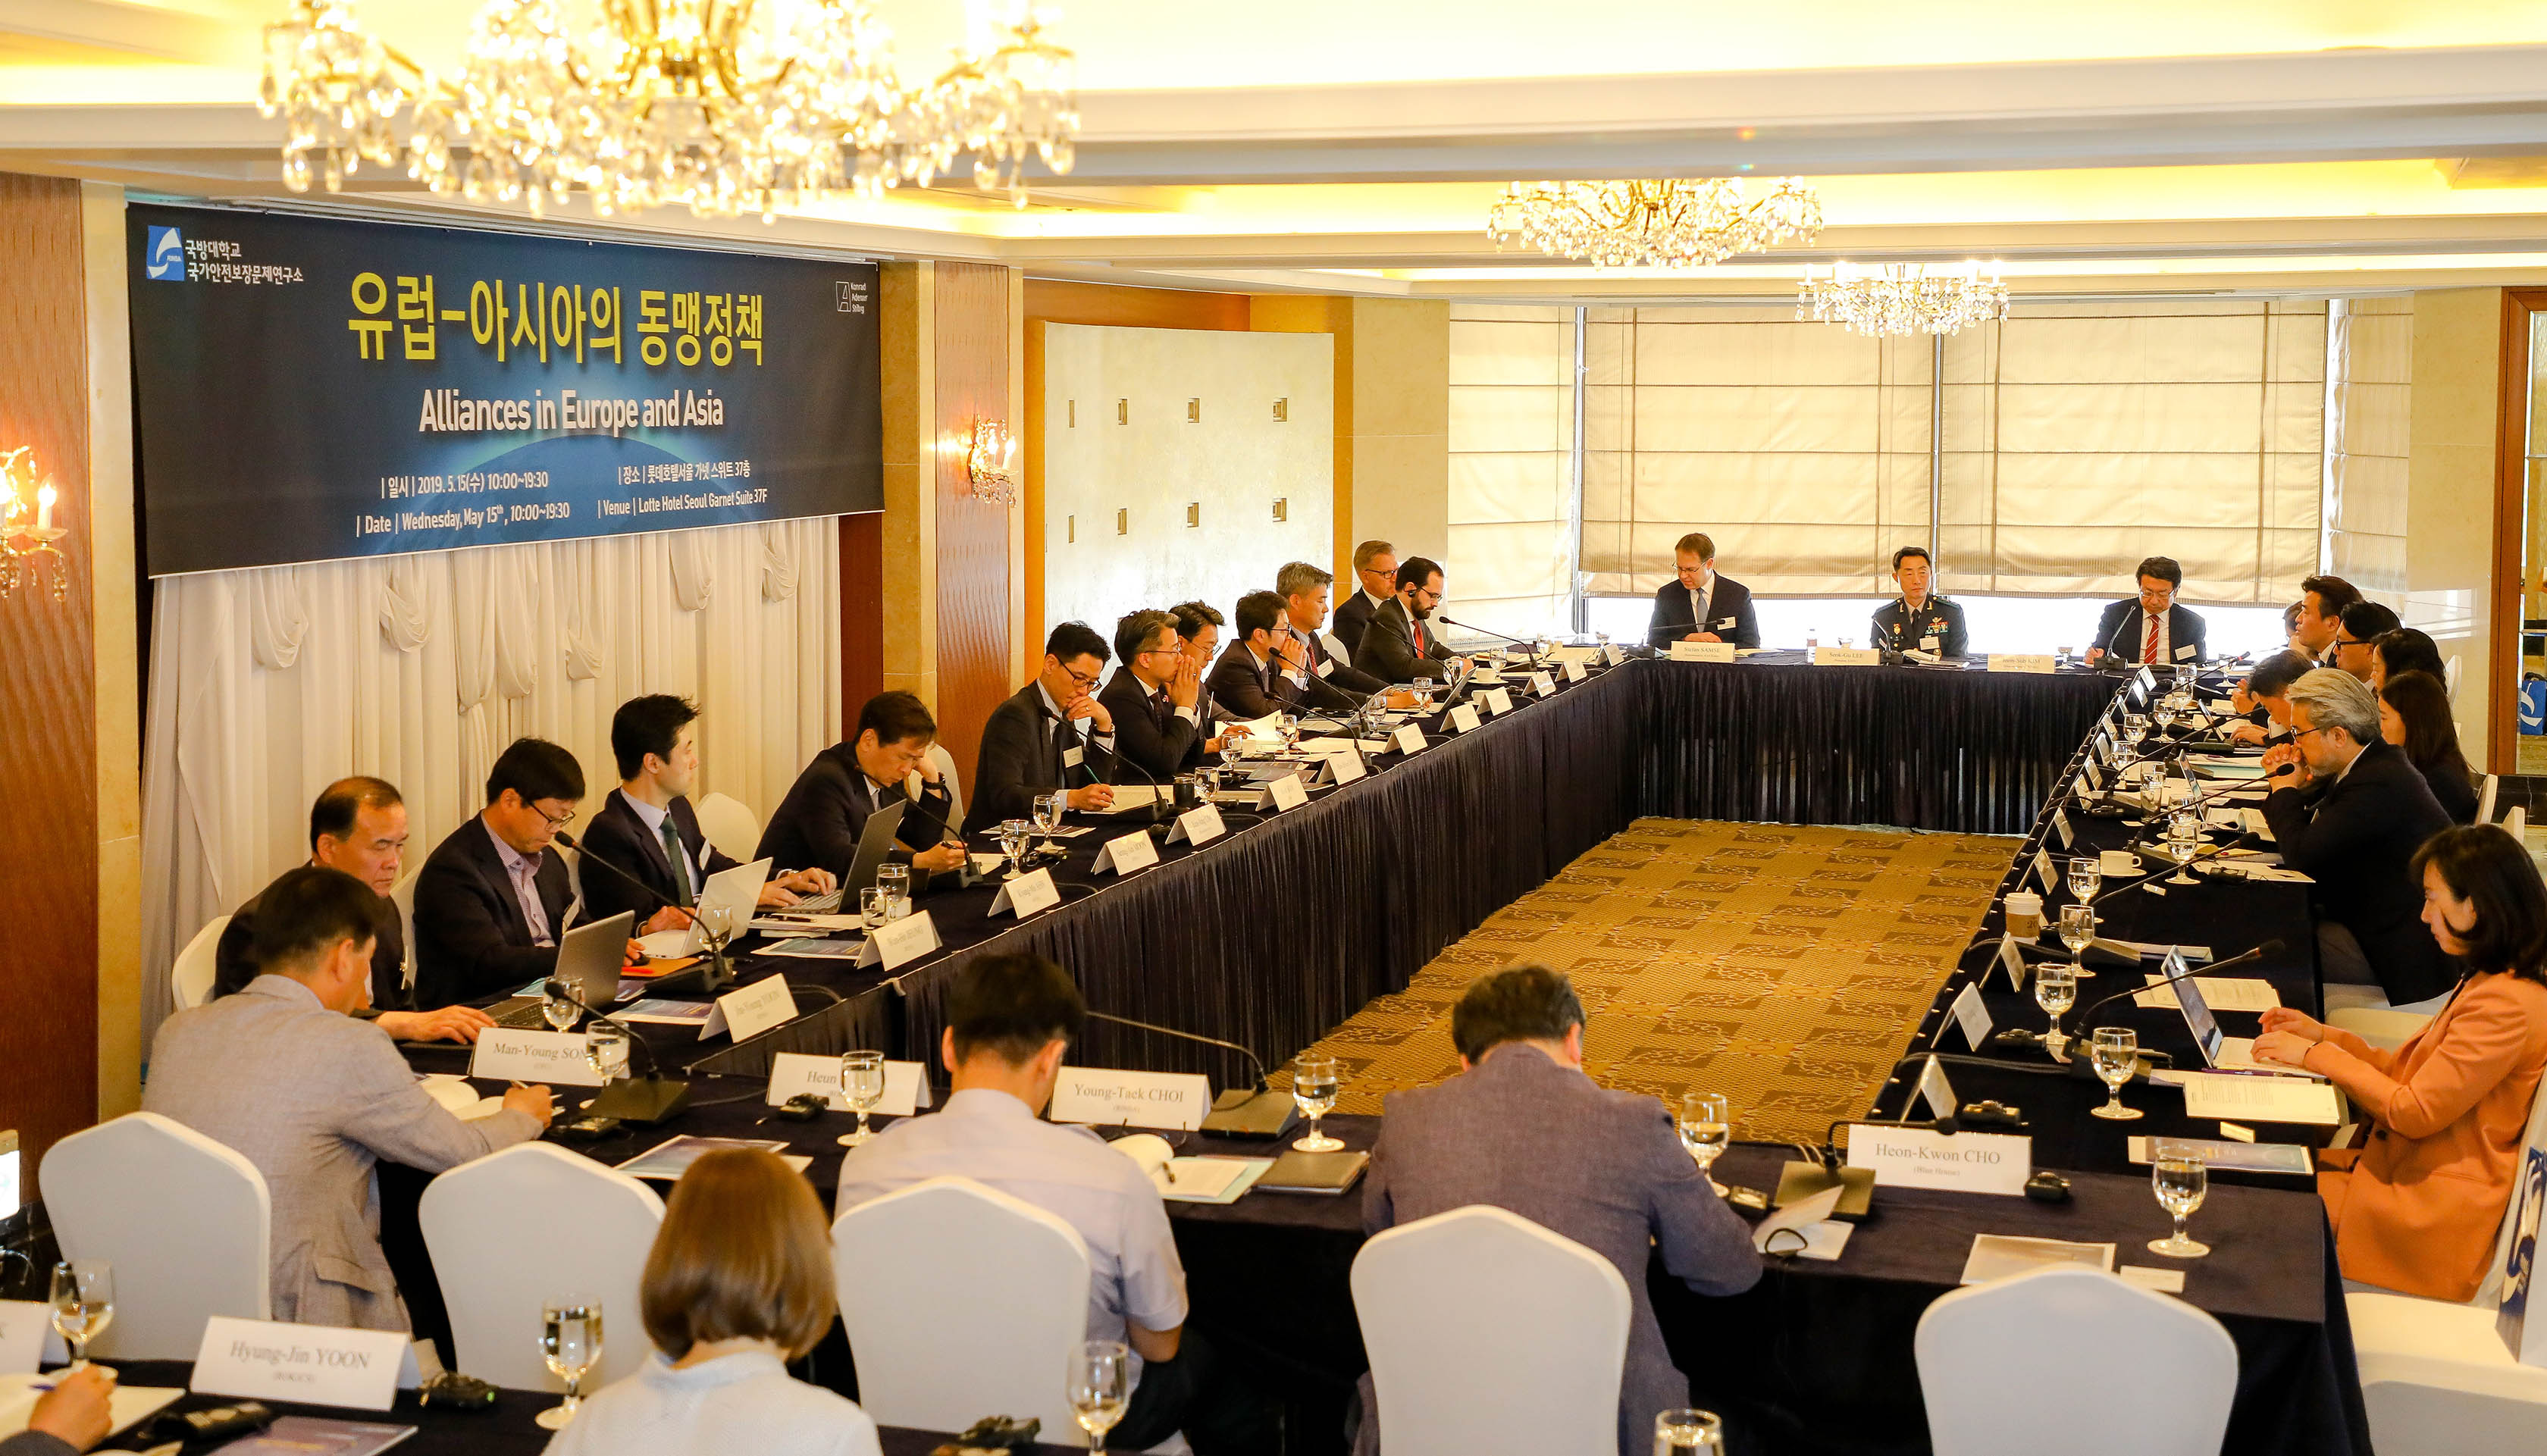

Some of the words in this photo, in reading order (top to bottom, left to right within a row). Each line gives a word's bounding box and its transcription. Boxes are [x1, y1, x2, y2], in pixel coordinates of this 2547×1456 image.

[185, 240, 242, 261] 국방대학교
[187, 262, 304, 285] 국가안전보장문제연구소
[348, 272, 622, 364] 유럽-아시아의
[637, 290, 763, 366] 동맹정책
[418, 389, 531, 432] Alliances
[535, 389, 557, 430] in
[561, 390, 639, 437] Europe
[642, 389, 680, 427] and
[683, 389, 724, 426] Asia
[623, 465, 641, 485] 장소
[647, 463, 694, 484] 롯데호텔서울
[694, 462, 710, 481] 가넷
[710, 460, 735, 480] 스위트
[735, 459, 750, 478] 37층
[388, 476, 409, 499] 일시
[418, 475, 446, 494] 2019.
[458, 472, 485, 493] 15(수)
[487, 471, 549, 490] 10:00~19:30
[603, 499, 631, 516] Venue
[638, 497, 660, 514] Lotte
[662, 494, 683, 512] Hotel
[684, 492, 708, 510] Seoul
[709, 490, 735, 508] Garnet
[735, 489, 753, 506] Suite
[753, 488, 768, 503] 37F
[365, 515, 392, 534] Date
[402, 510, 462, 531] Wednesday,
[463, 507, 484, 528] May
[510, 502, 571, 522] 10:00~19:30
[493, 1042, 559, 1061] Man-Young
[1148, 1088, 1184, 1103] CHOI
[1875, 1143, 1960, 1163] Heon-Kwon
[1963, 1148, 2001, 1165] CHO
[315, 1348, 371, 1369] YOON
